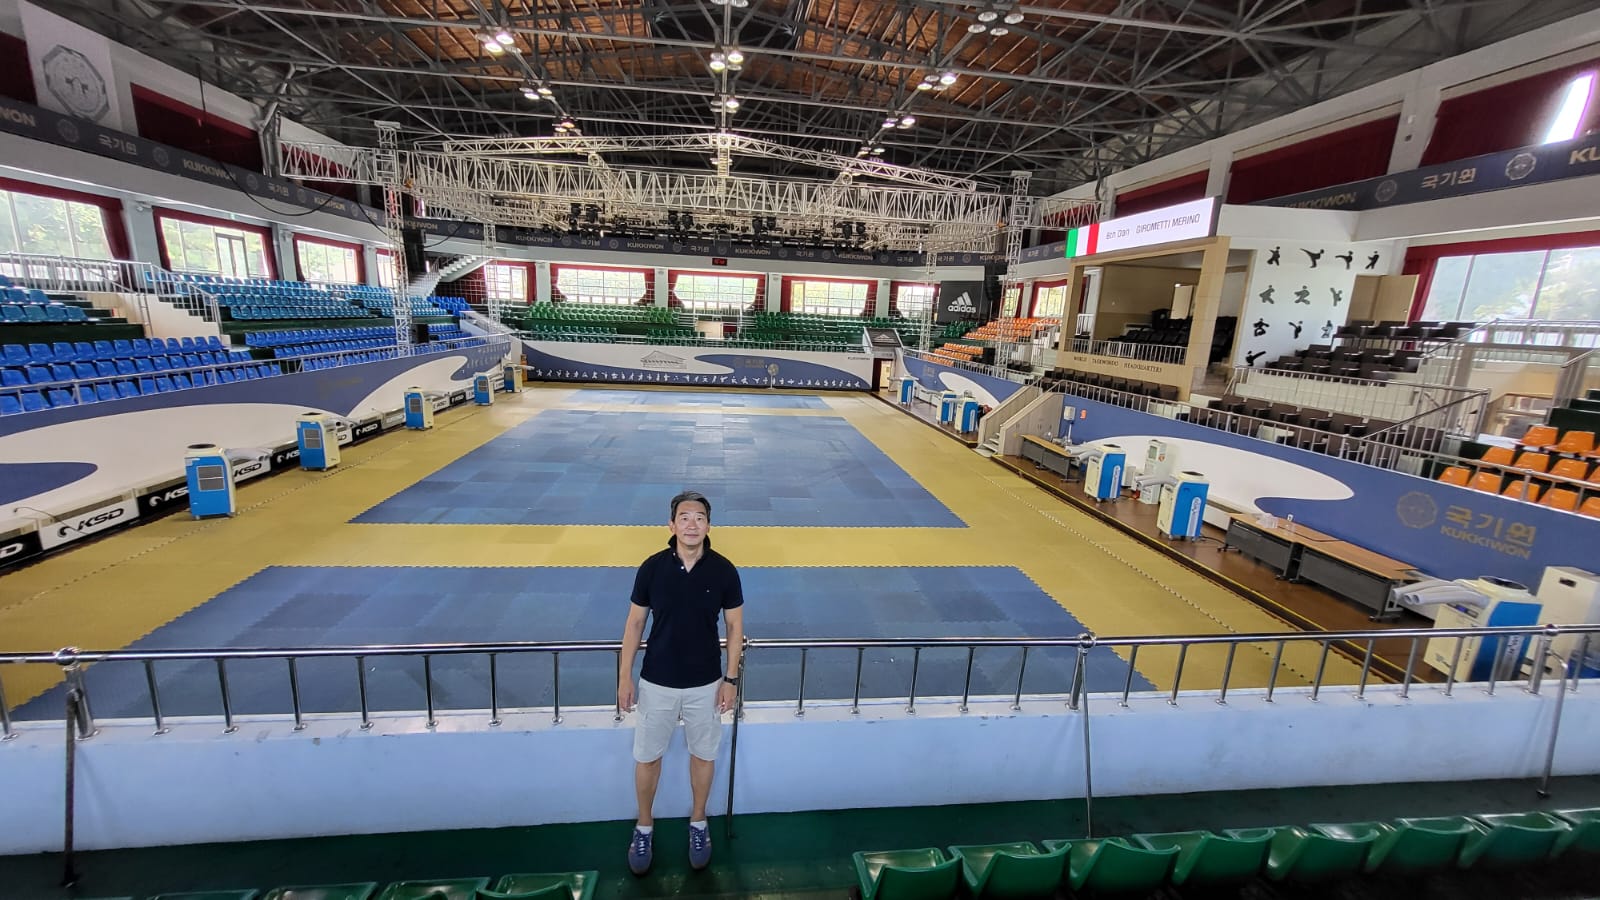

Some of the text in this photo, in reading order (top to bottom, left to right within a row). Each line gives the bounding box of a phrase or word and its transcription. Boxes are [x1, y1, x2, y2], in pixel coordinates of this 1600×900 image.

[1421, 166, 1477, 190] 국기원
[1172, 213, 1201, 228] MERINO
[947, 304, 977, 314] adidas
[285, 449, 300, 461] KS
[233, 462, 263, 478] KSD
[164, 487, 188, 502] KS
[76, 507, 125, 531] KSD
[1445, 505, 1537, 547] 국기원
[1440, 525, 1532, 561] KUKKIWON
